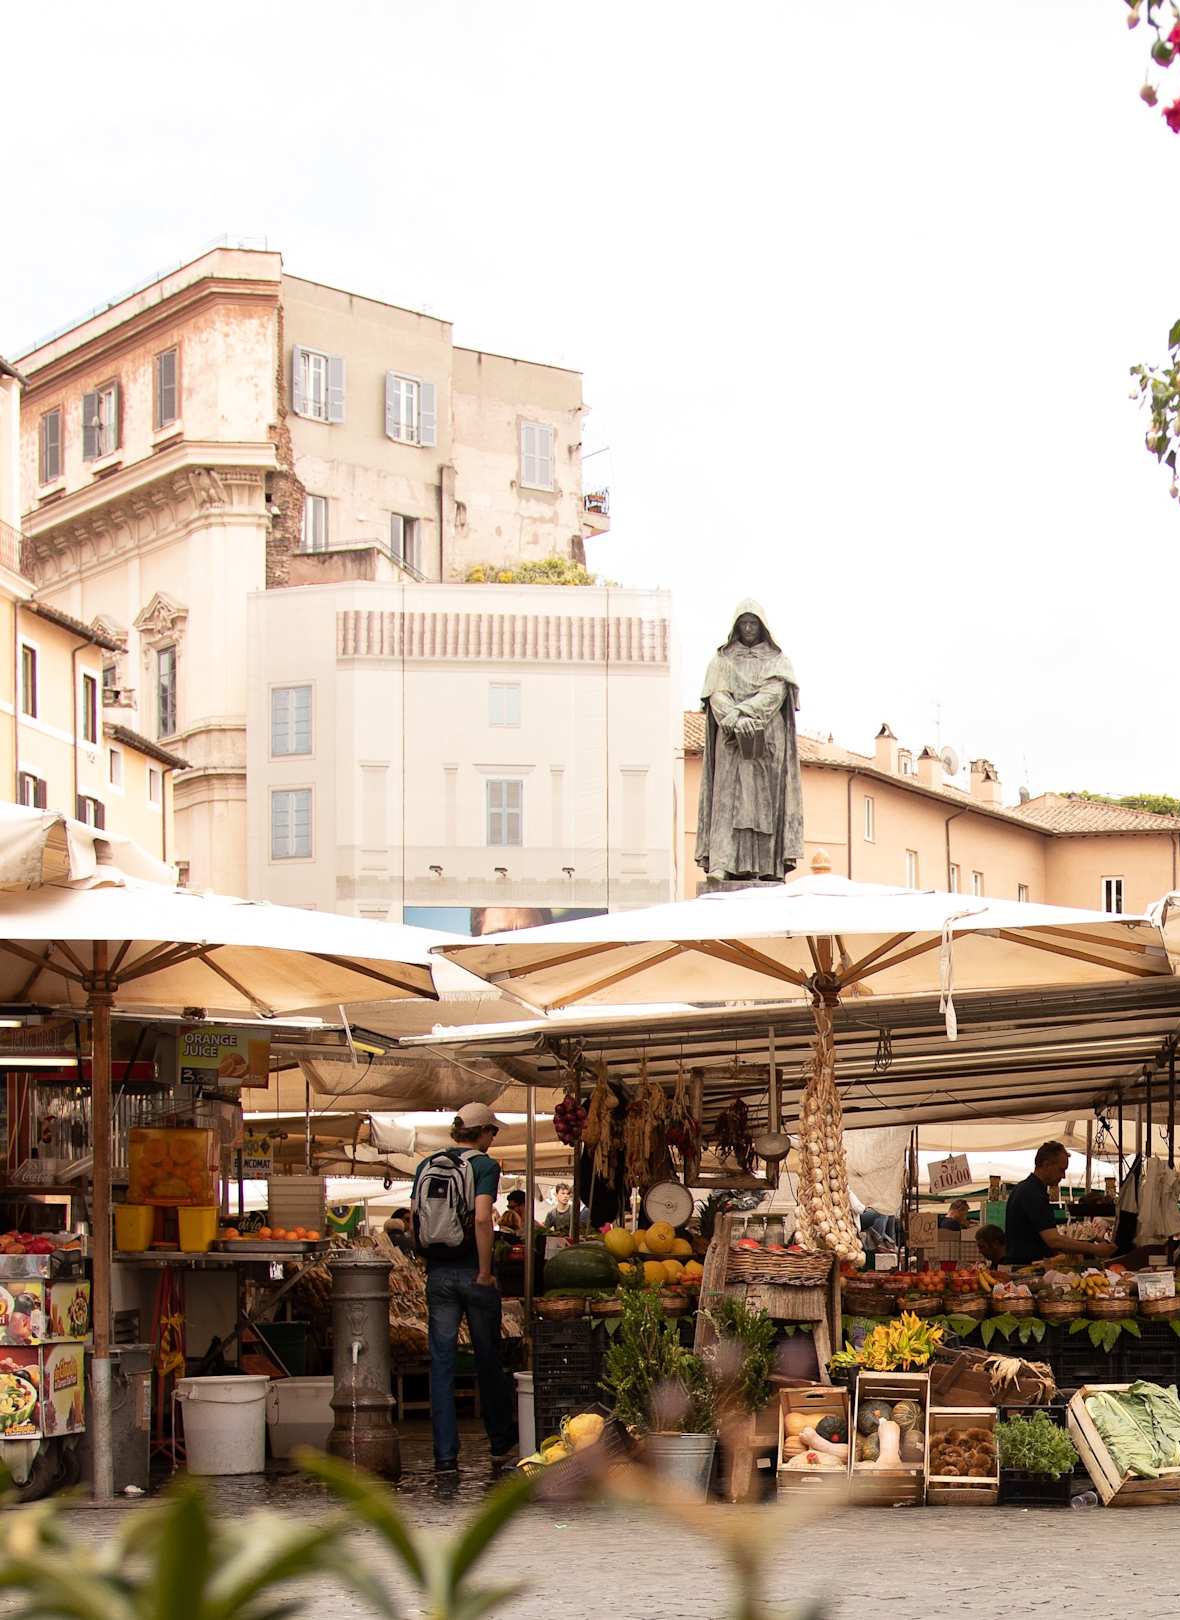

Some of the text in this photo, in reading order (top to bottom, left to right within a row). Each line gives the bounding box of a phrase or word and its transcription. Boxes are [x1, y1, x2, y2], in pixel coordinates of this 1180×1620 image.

[184, 1032, 238, 1046] ORANGE
[184, 1045, 217, 1057] JUICE
[933, 1167, 970, 1190] €10.00
